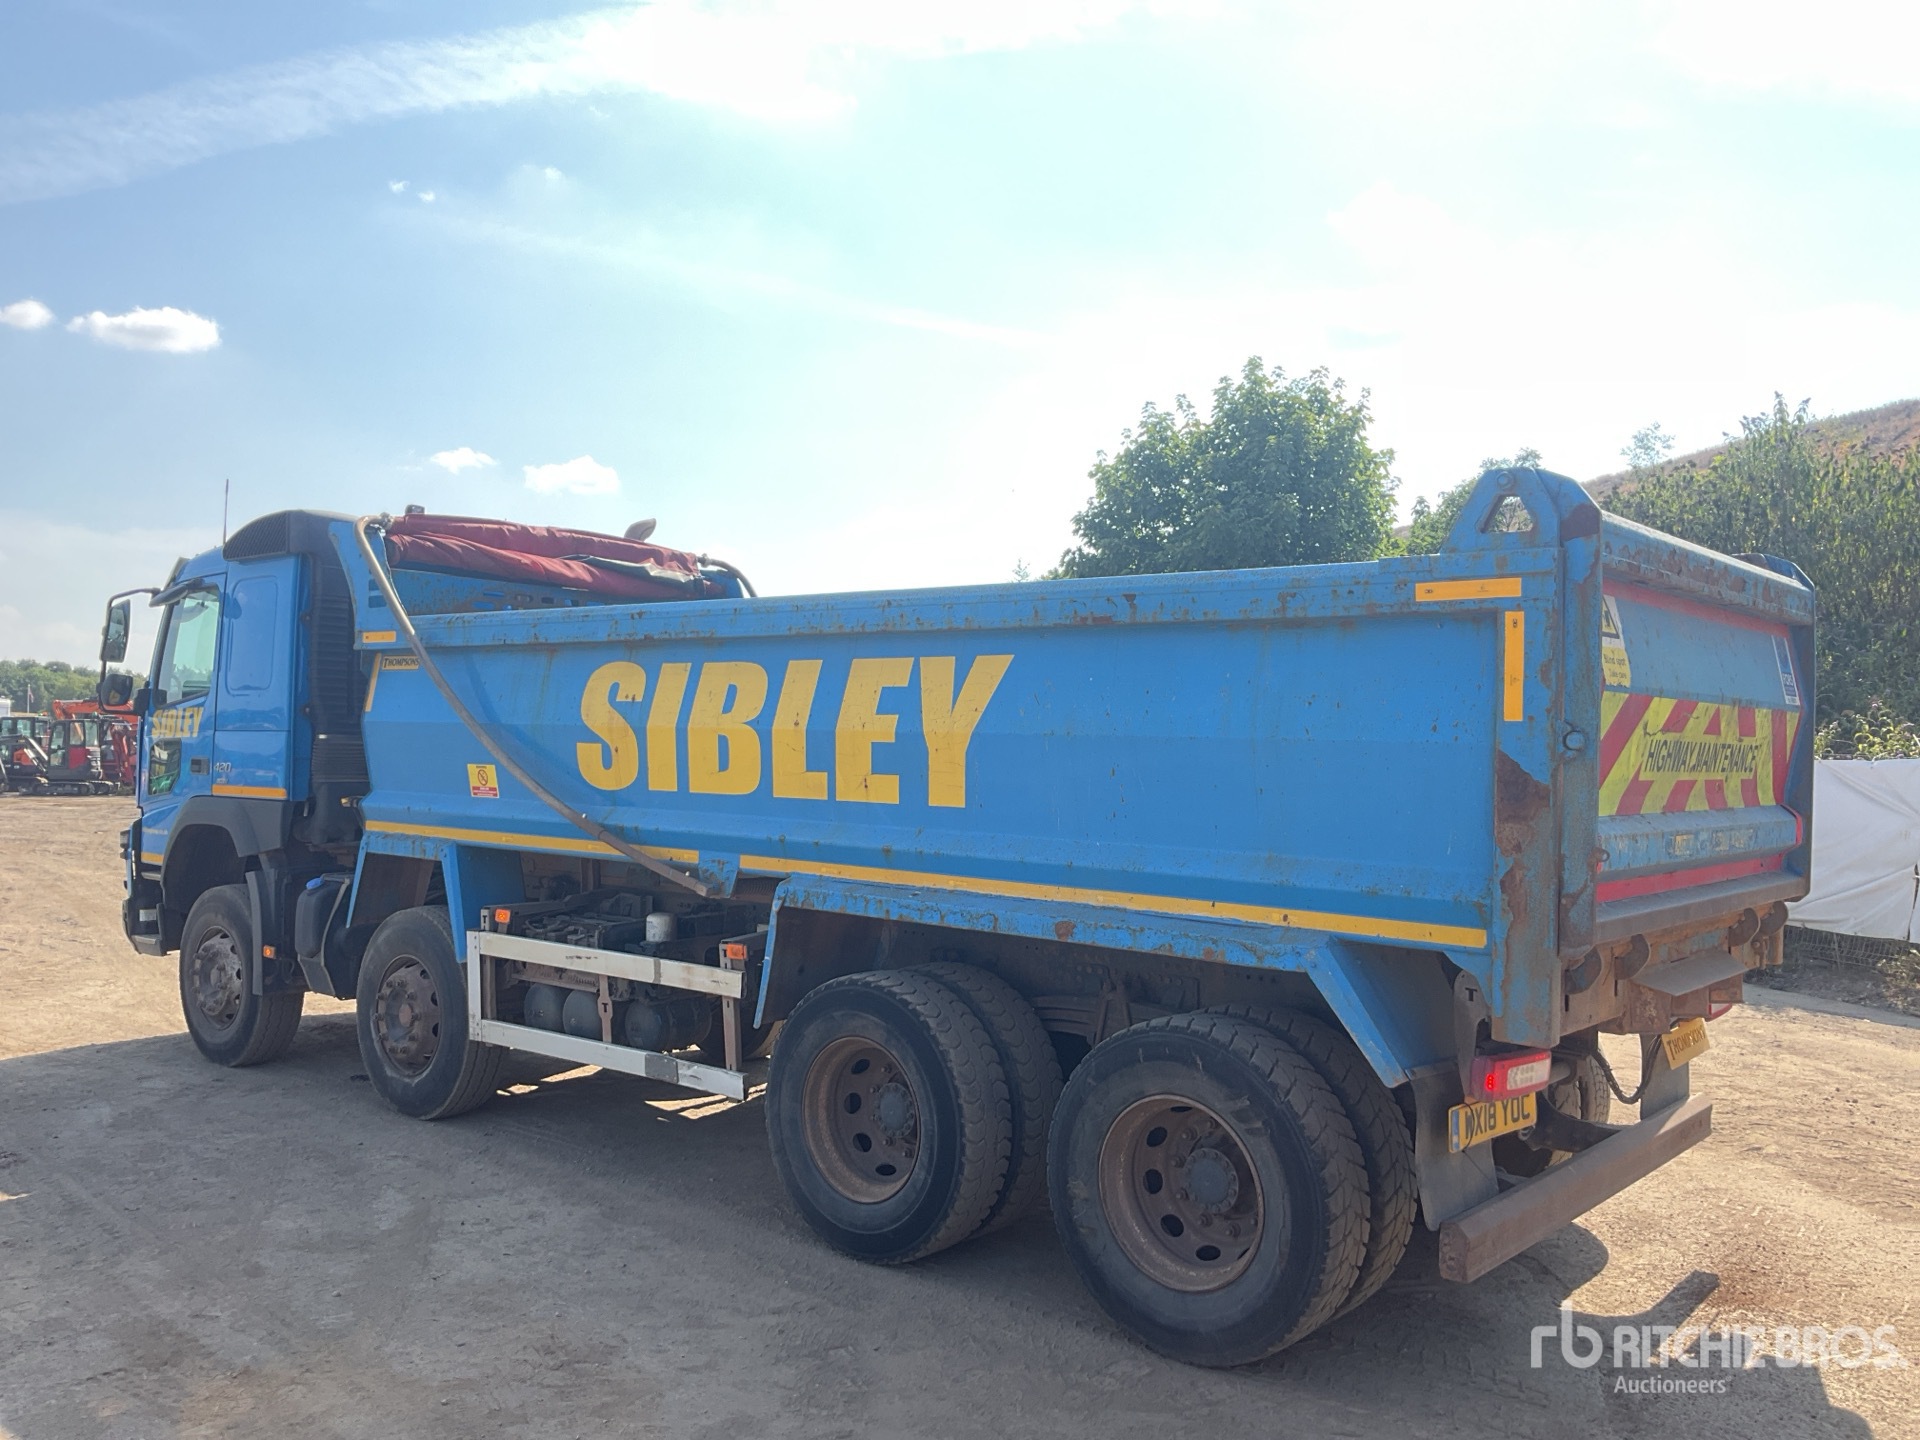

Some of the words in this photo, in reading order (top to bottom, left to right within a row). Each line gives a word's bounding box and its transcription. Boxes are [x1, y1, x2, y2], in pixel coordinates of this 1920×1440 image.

[151, 706, 204, 737] SIBLEY
[576, 654, 1015, 809] SIBLEY
[214, 762, 232, 772] 420
